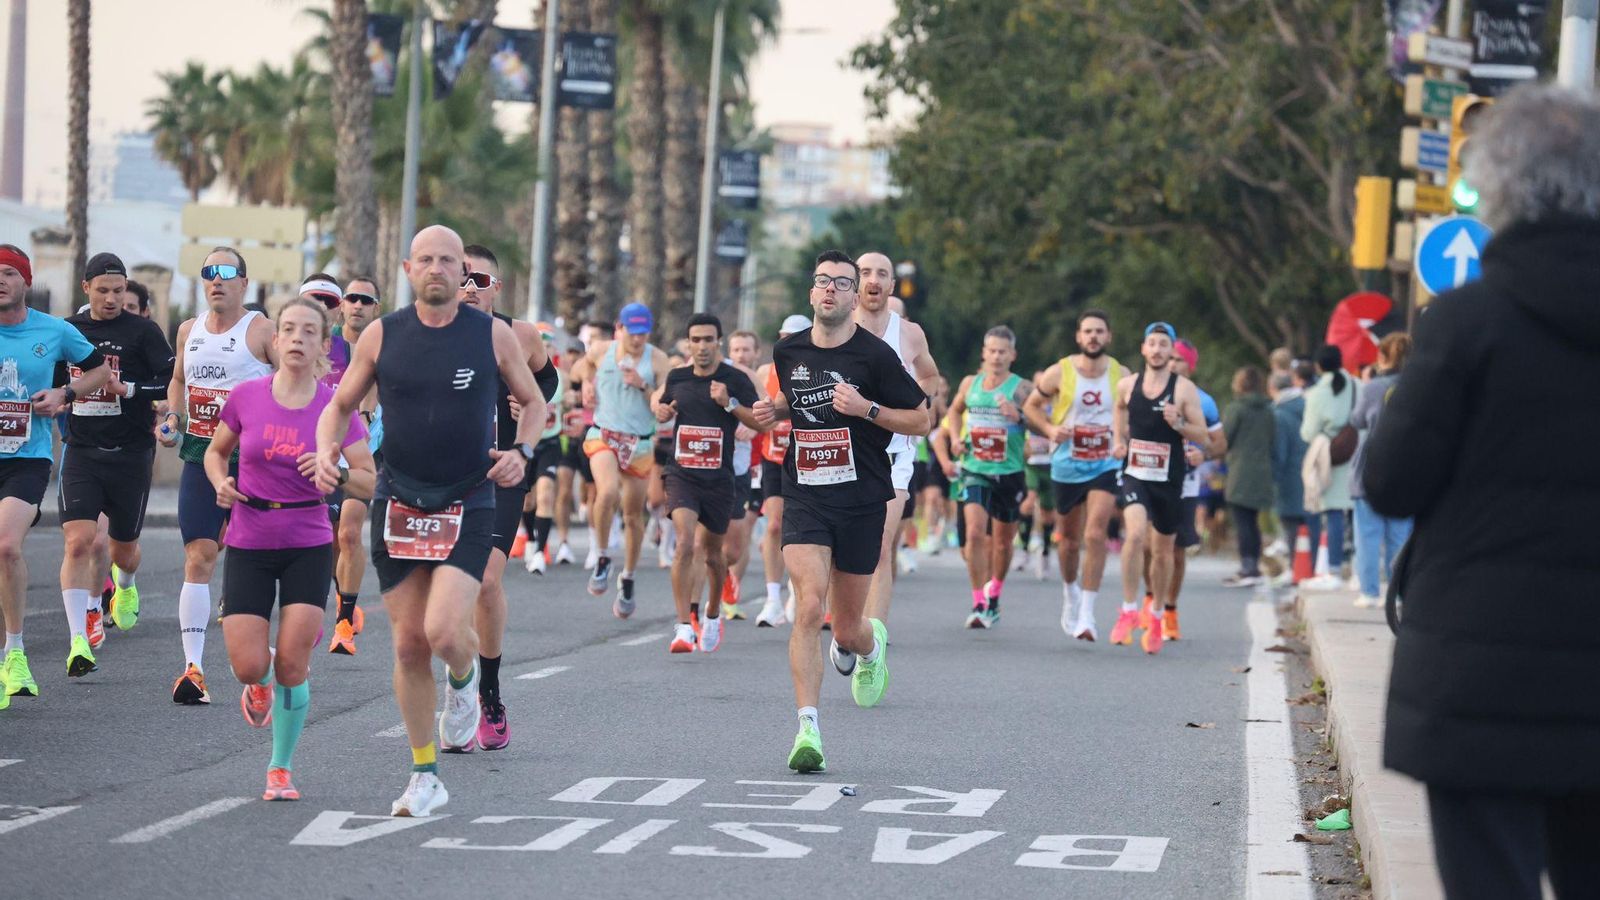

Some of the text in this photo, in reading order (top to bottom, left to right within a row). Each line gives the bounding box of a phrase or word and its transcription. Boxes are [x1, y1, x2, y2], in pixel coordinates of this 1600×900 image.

[193, 366, 227, 379] LLORCA
[195, 404, 218, 416] 1447
[0, 420, 17, 430] 24
[263, 424, 299, 445] RUN
[806, 431, 845, 441] GENERALI
[688, 440, 711, 450] 6855
[806, 449, 839, 461] 14997
[406, 517, 441, 532] 2973
[549, 776, 1007, 818] RED
